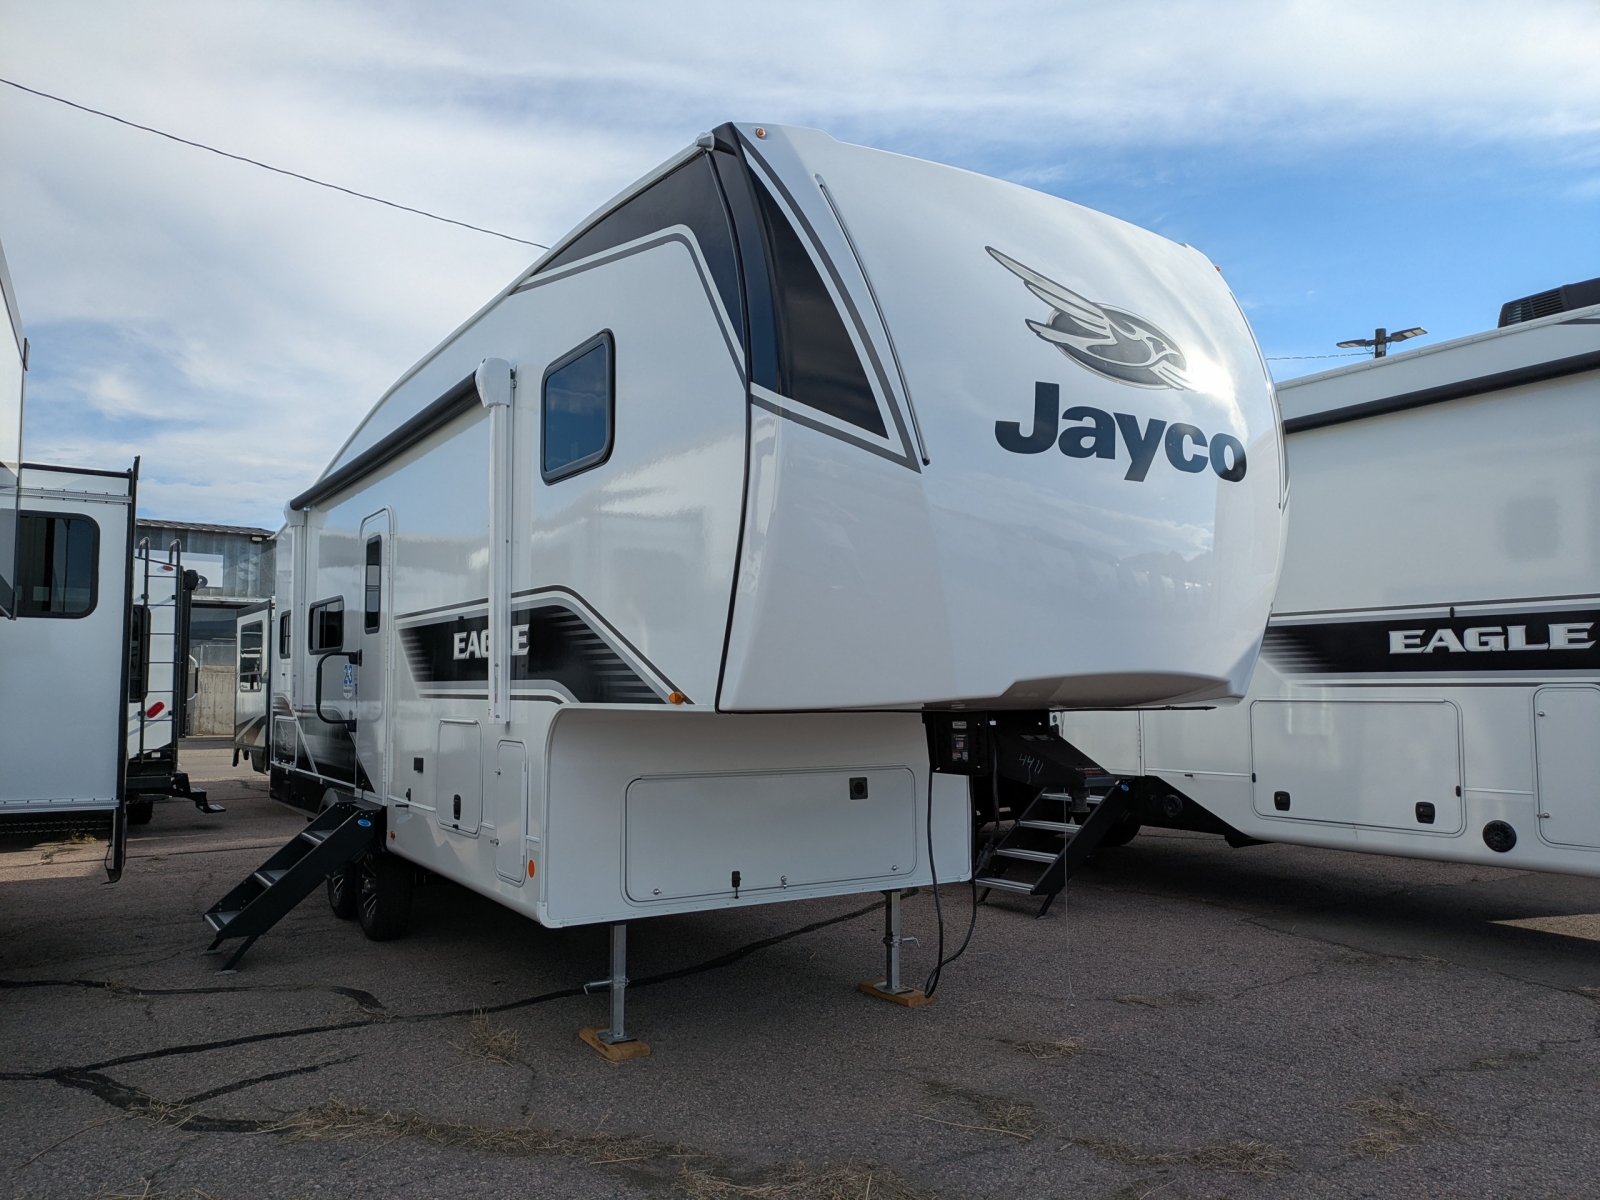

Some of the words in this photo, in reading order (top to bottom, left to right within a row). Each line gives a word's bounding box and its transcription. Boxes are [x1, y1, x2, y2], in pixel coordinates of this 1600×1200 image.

[995, 381, 1247, 482] Jayco
[453, 624, 530, 660] EAGE
[1388, 622, 1595, 654] EAGLE
